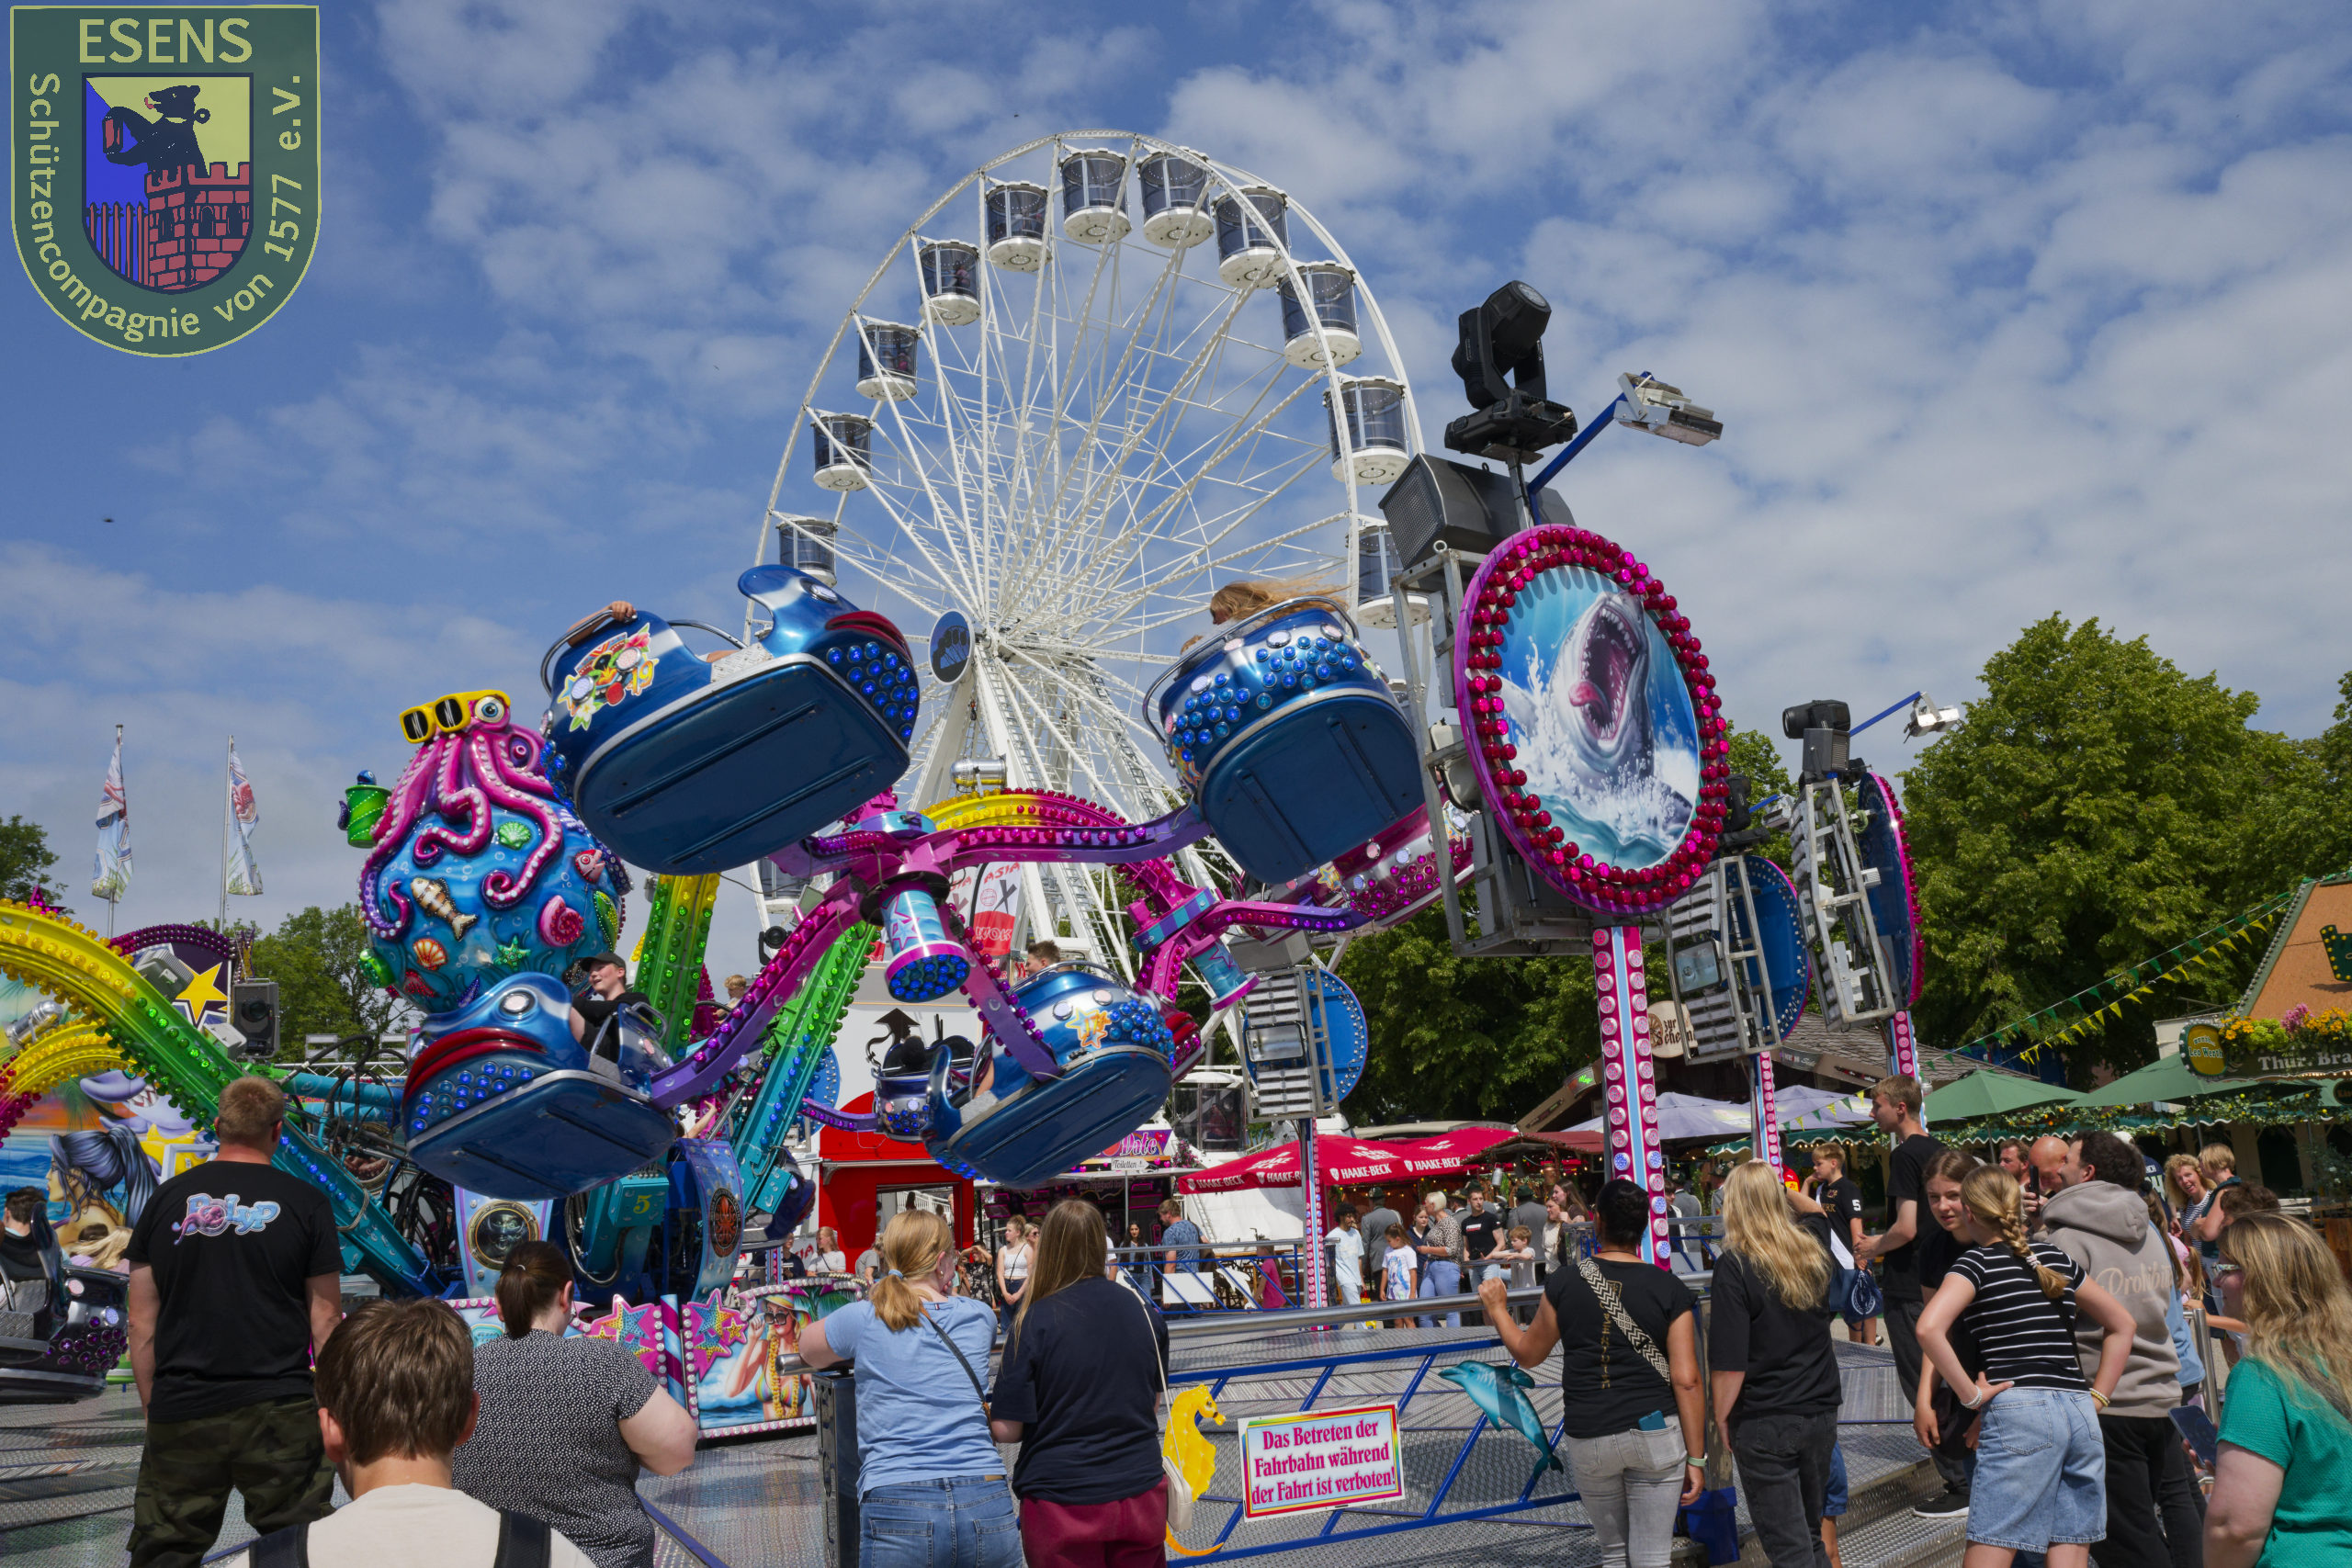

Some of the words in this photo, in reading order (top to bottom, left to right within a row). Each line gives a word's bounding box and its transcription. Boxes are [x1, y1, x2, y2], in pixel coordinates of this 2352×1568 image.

[984, 862, 1020, 884] ASIA
[950, 875, 972, 892] SIA
[975, 926, 1012, 942] WOK
[2188, 1046, 2201, 1057] Leo
[1120, 1132, 1157, 1156] Date
[1113, 1159, 1137, 1169] Toiletten
[1340, 1163, 1393, 1179] HAAKE-BECK
[1414, 1156, 1463, 1171] HAAKE-BECK
[1196, 1175, 1245, 1189] HAAKE-BECK
[1266, 1170, 1303, 1183] HAAKE-B
[633, 1194, 652, 1214] 5
[1851, 1199, 1861, 1212] 5
[1262, 1430, 1290, 1450] Das
[1293, 1424, 1352, 1446] Betreten
[1355, 1418, 1378, 1438] der
[1254, 1451, 1325, 1478] Fahrbahn
[1328, 1440, 1389, 1468] während
[1251, 1484, 1274, 1506] der
[1277, 1478, 1314, 1502] Fahrt
[1316, 1475, 1333, 1496] ist
[1335, 1465, 1396, 1493] verboten!
